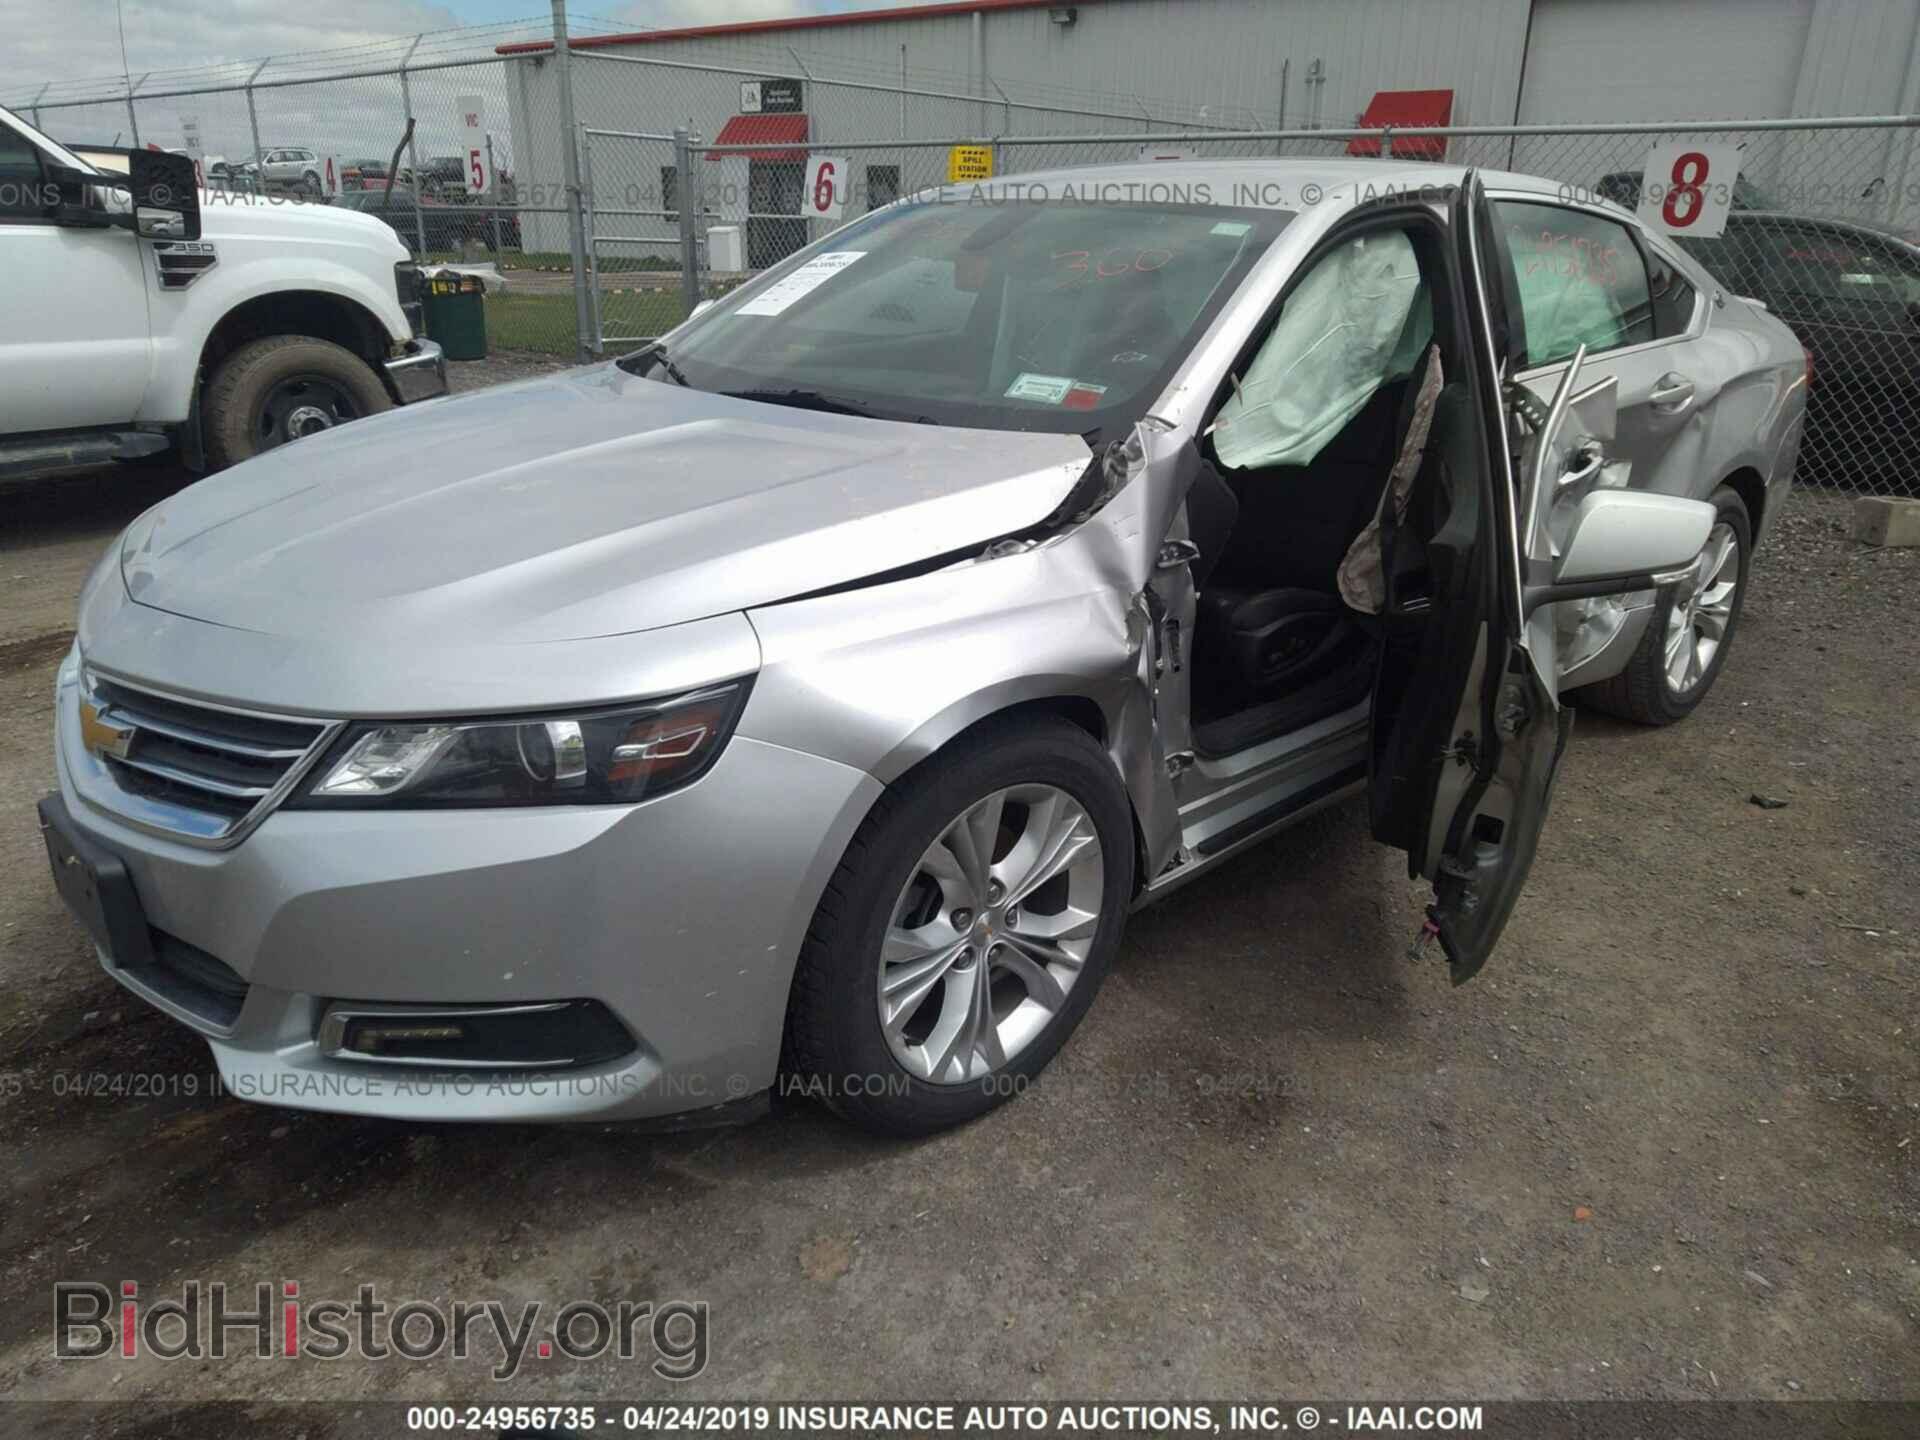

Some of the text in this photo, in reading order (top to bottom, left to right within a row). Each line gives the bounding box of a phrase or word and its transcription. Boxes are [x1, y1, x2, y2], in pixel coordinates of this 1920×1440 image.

[325, 157, 336, 192] 4
[470, 149, 483, 189] 5
[814, 161, 834, 212] 6
[958, 165, 987, 173] STATION
[1661, 152, 1710, 228] 8
